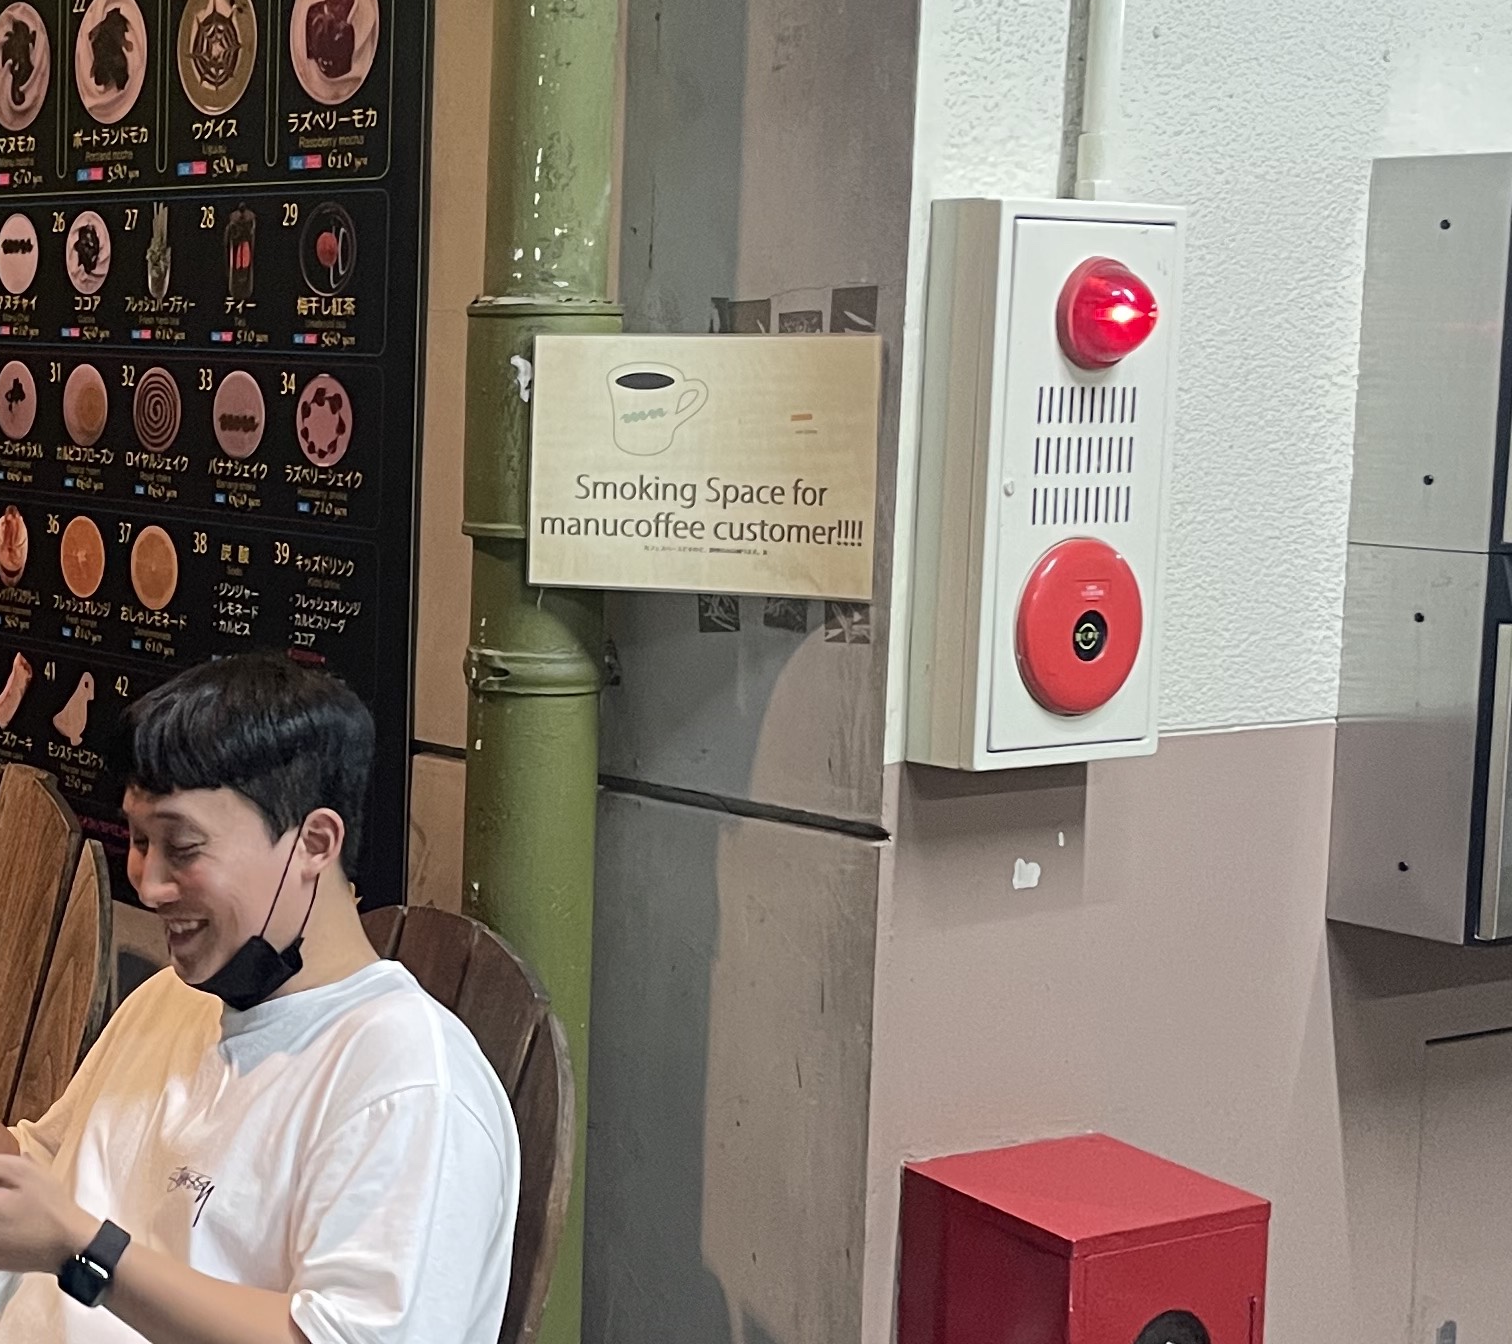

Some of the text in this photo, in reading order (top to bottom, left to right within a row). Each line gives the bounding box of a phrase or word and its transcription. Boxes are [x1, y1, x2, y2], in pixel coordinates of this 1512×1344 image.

[288, 108, 378, 134] ラズベリーモカ
[327, 149, 352, 169] 610
[52, 211, 66, 233] 26
[124, 209, 138, 231] 27
[200, 206, 215, 229] 28
[282, 203, 299, 226] 29
[74, 296, 101, 312] ココア
[224, 296, 257, 314] ティー
[49, 361, 62, 383] 31
[121, 365, 135, 387] 32
[198, 368, 213, 391] 33
[280, 371, 296, 395] 34
[285, 464, 363, 489] ラズベリーシェイク
[574, 473, 828, 509] Smoking Space for
[46, 514, 60, 534] 36
[118, 522, 132, 544] 37
[540, 512, 865, 548] manucoffee customer!!!!
[192, 531, 208, 554] 38
[273, 541, 290, 565] 39
[295, 553, 355, 577] キッズドリンク
[219, 601, 259, 620] レモネード
[294, 593, 362, 616] フレッシュオレンジ
[294, 632, 316, 646] ココア
[44, 661, 56, 681] 41
[114, 676, 129, 697] 42
